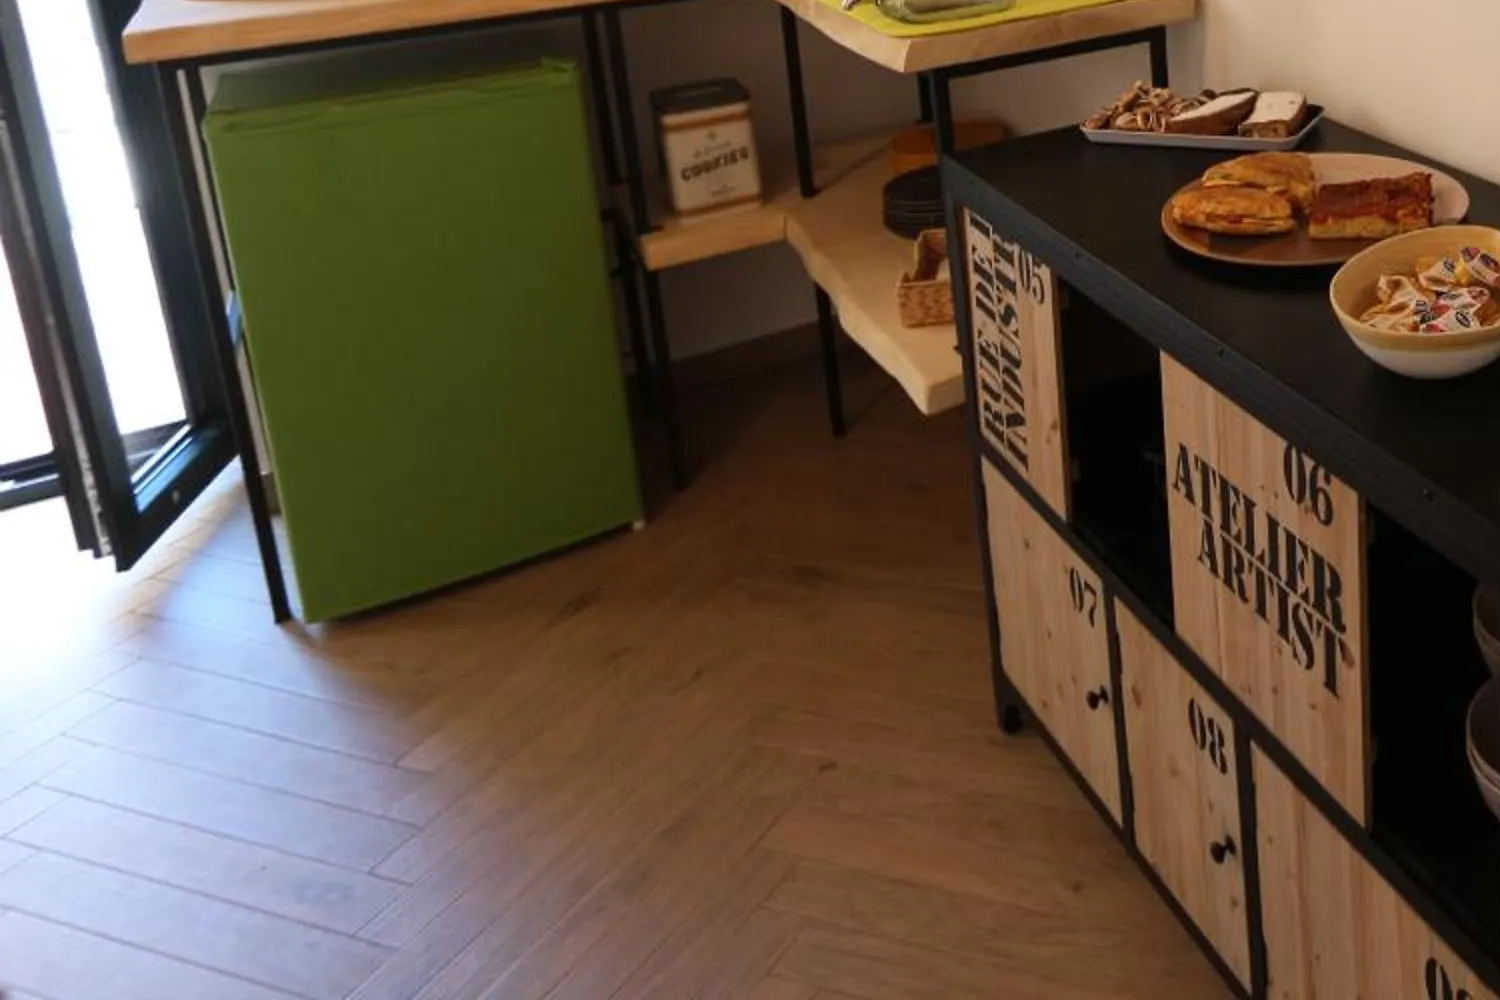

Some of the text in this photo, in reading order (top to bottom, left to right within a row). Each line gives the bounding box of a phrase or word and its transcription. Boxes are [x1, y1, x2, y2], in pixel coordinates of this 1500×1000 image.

[681, 145, 749, 181] COOKIES
[1019, 247, 1045, 305] 05
[977, 328, 1006, 446] RUE
[1283, 444, 1334, 527] 06
[1173, 442, 1347, 635] ATELIER
[1069, 566, 1097, 628] 07
[1197, 517, 1352, 700] ARTIST
[1188, 698, 1228, 775] 08
